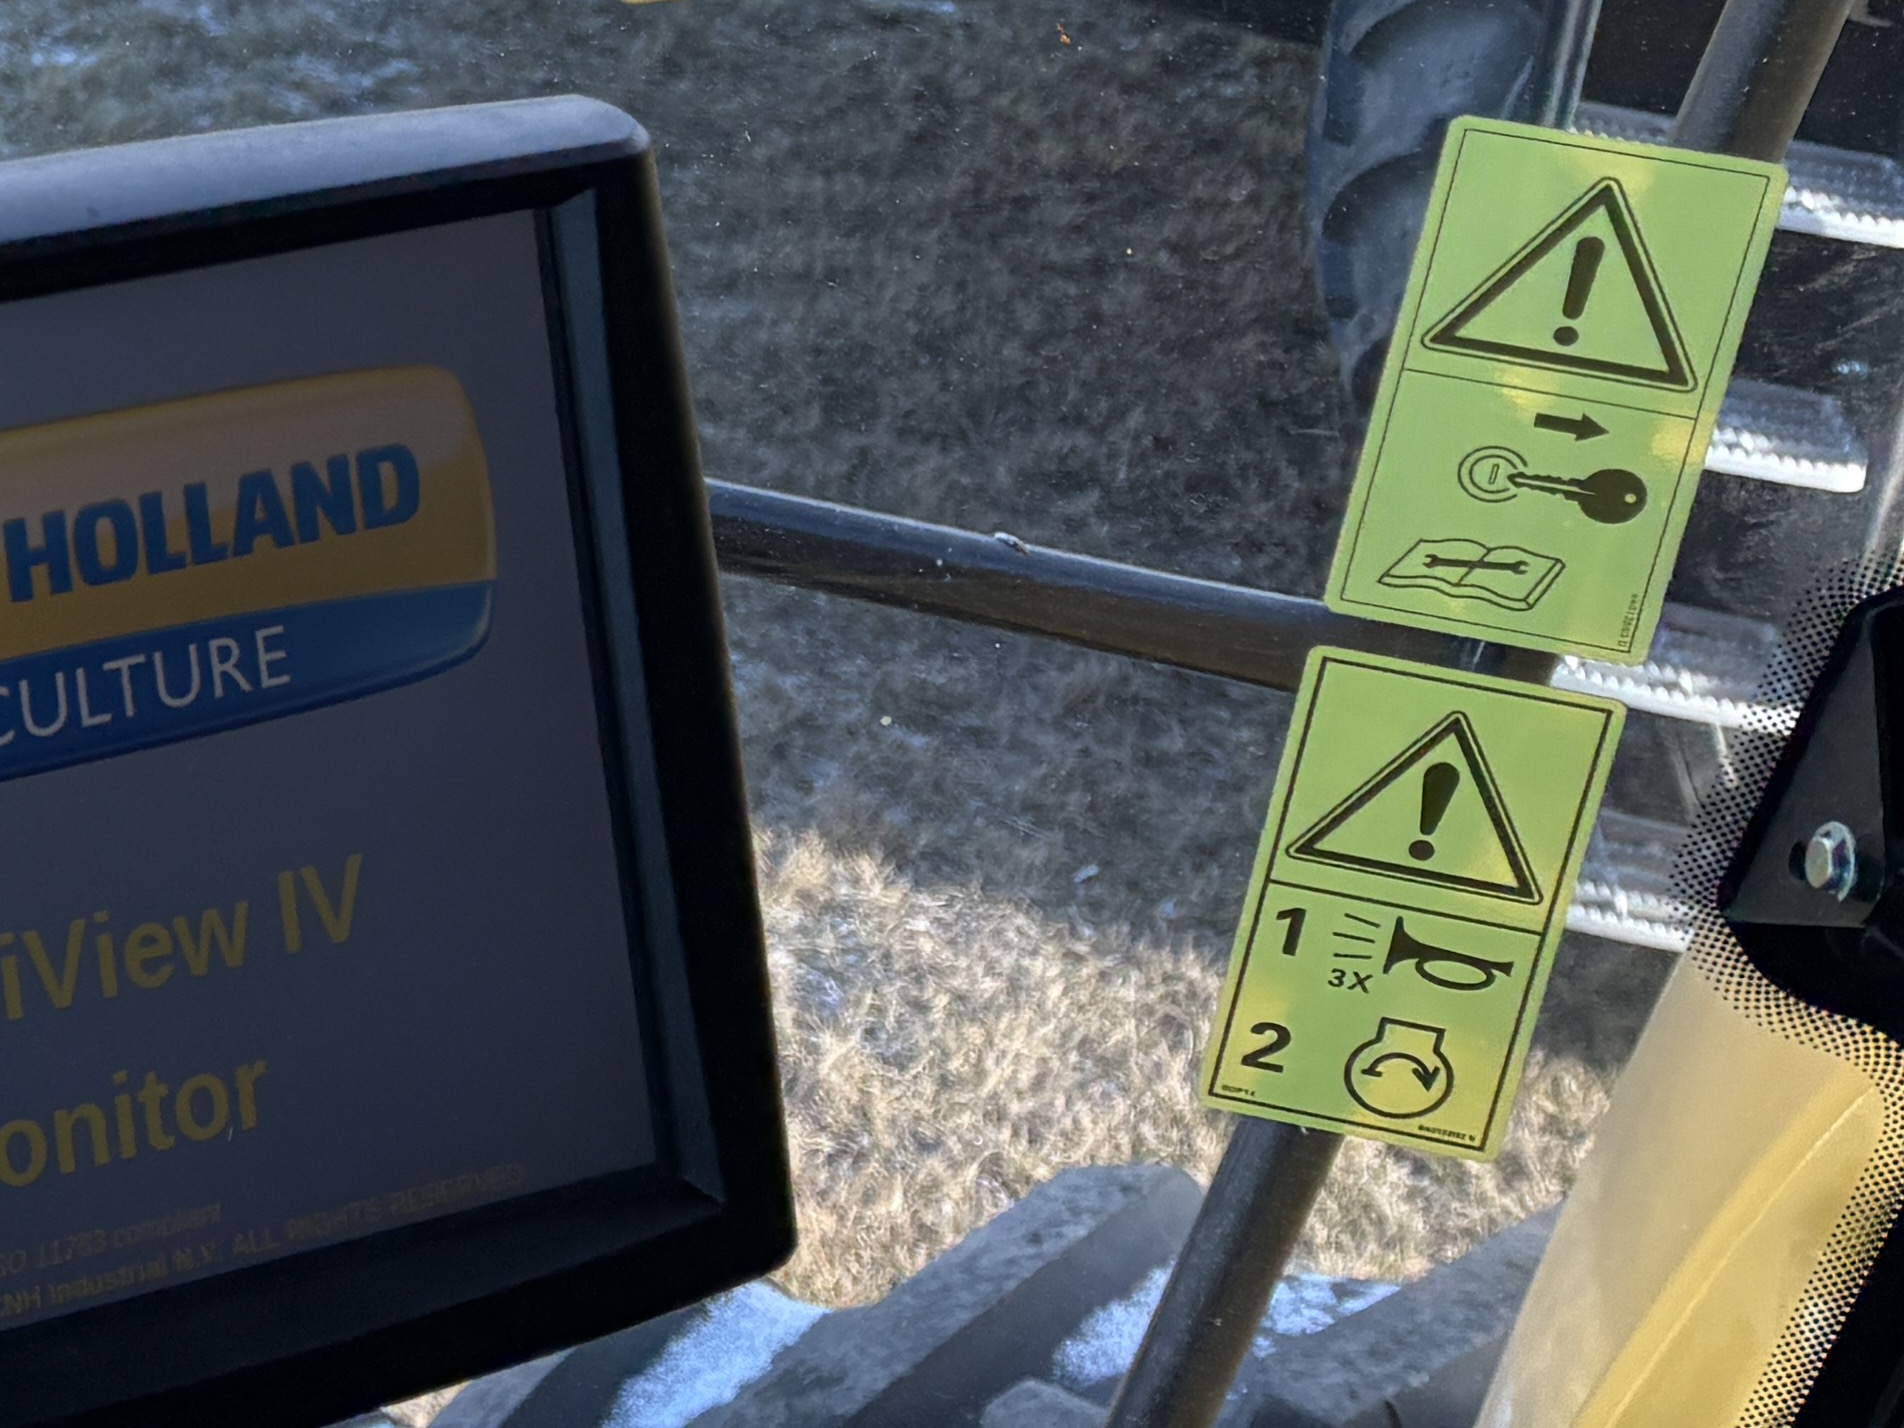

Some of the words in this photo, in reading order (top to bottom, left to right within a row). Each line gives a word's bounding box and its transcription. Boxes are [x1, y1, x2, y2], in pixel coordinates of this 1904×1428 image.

[1, 442, 421, 604] HOLLAND
[277, 853, 363, 954] IV
[1276, 907, 1307, 956] 1
[1328, 968, 1374, 994] 3X
[1240, 1021, 1292, 1074] 2
[36, 1227, 107, 1270] 11783
[48, 1254, 168, 1305] Industrial
[231, 1227, 281, 1256] ALL
